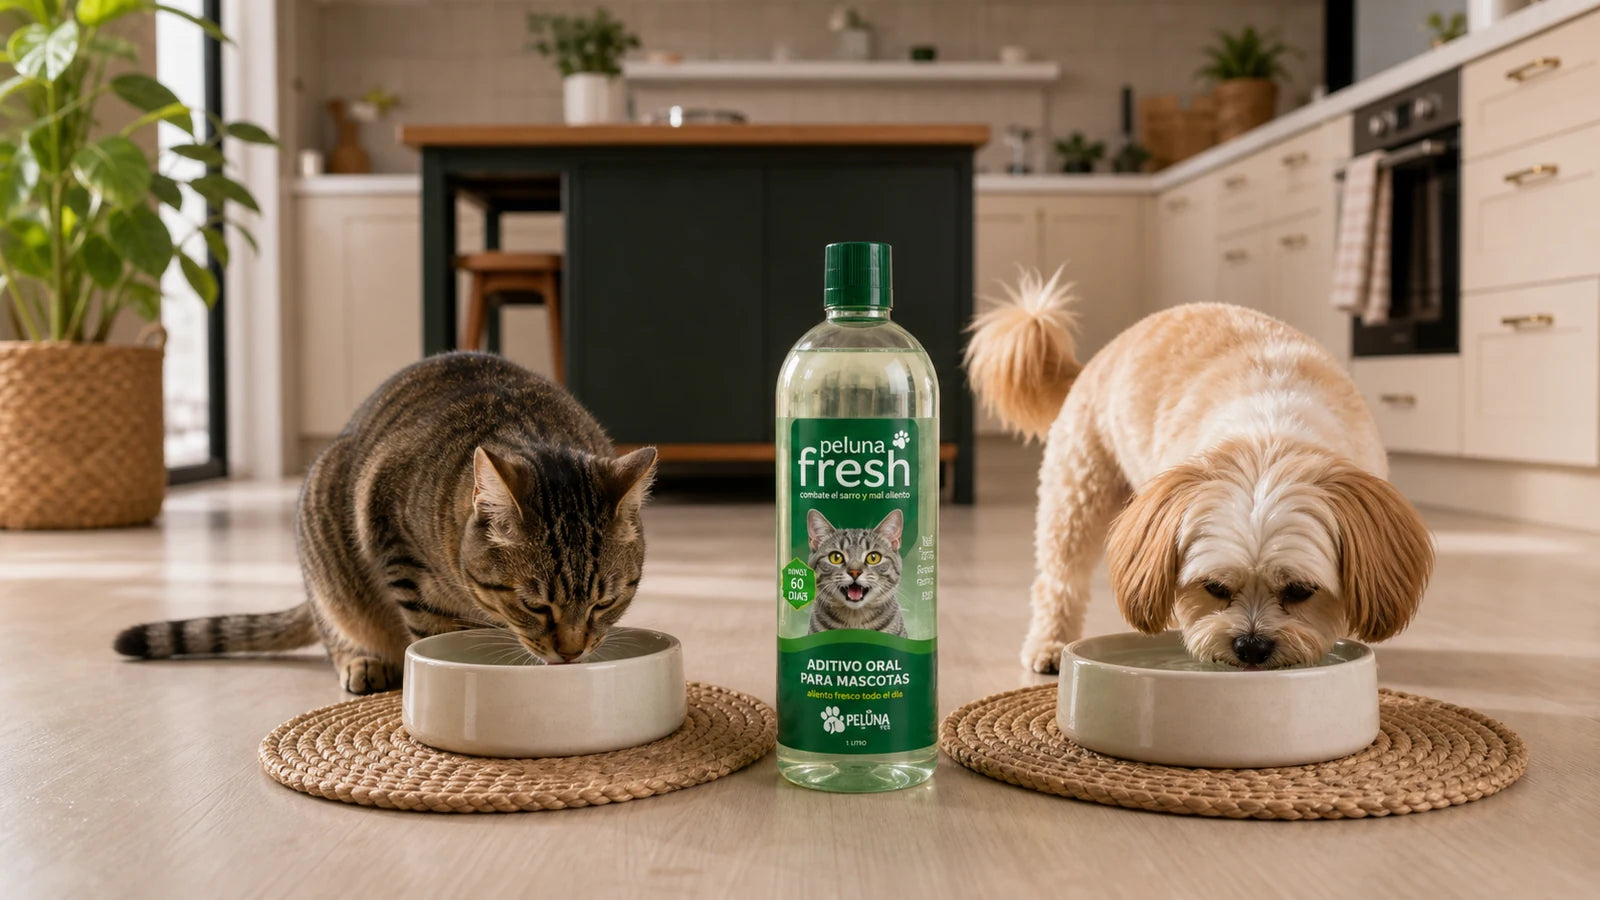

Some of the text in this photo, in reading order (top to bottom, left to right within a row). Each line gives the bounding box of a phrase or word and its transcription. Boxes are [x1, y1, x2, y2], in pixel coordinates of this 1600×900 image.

[820, 436, 885, 458] peluna
[798, 446, 910, 487] fresh
[800, 491, 829, 499] combate
[831, 491, 838, 499] el
[862, 493, 867, 501] y
[869, 491, 884, 499] mal
[791, 577, 804, 590] 60
[807, 659, 902, 672] ADITIVO ORAL
[800, 672, 910, 687] PARA MASCOTAS
[834, 691, 860, 700] fresco
[862, 691, 881, 700] todo
[883, 691, 891, 699] el
